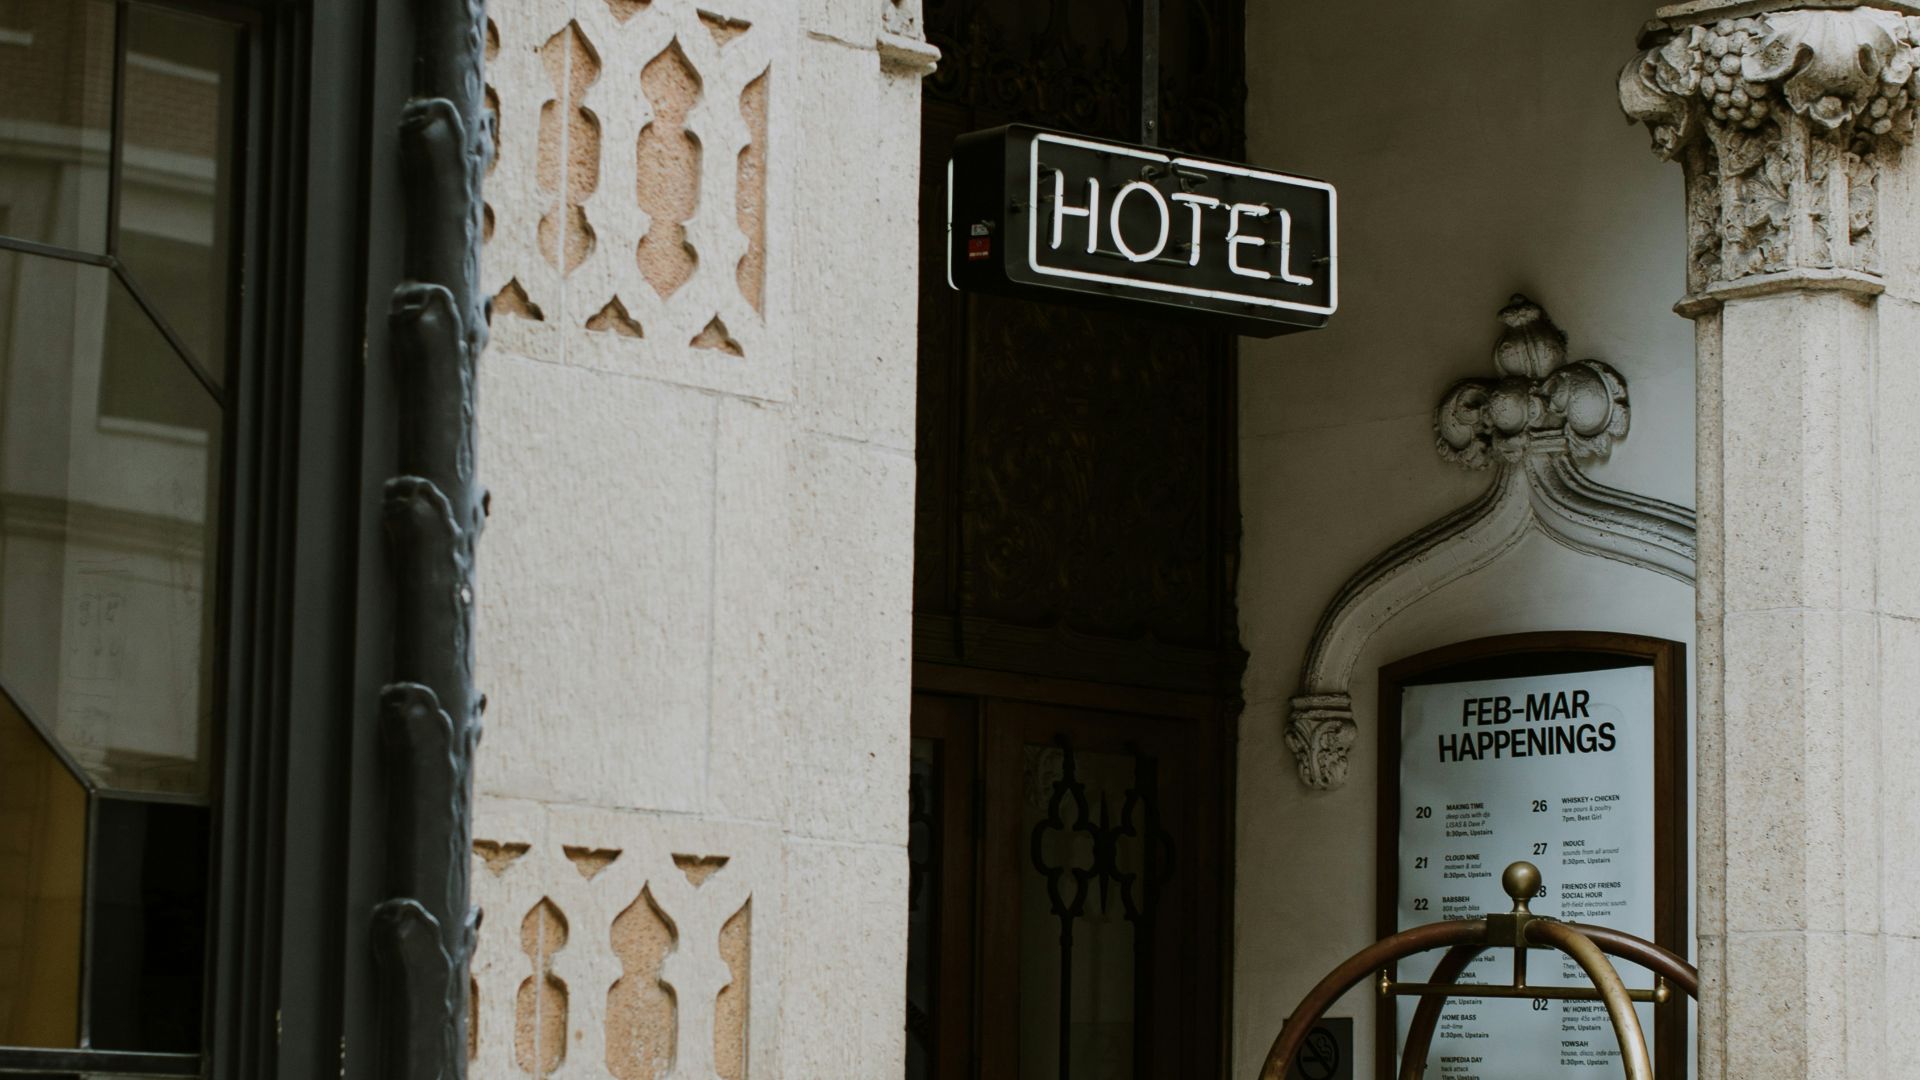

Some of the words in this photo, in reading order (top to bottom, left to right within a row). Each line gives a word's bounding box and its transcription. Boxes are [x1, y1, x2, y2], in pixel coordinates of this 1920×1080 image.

[1050, 168, 1313, 286] HOTEL
[1462, 689, 1590, 727] FEB-MAR
[1438, 722, 1616, 763] HAPPENINGS
[1532, 800, 1548, 812] 26
[1561, 796, 1589, 804] WHISKEY
[1416, 806, 1432, 818] 20
[1533, 842, 1548, 855] 27
[1414, 856, 1428, 868] 21
[1414, 898, 1428, 910] 22
[1532, 998, 1548, 1010] 02
